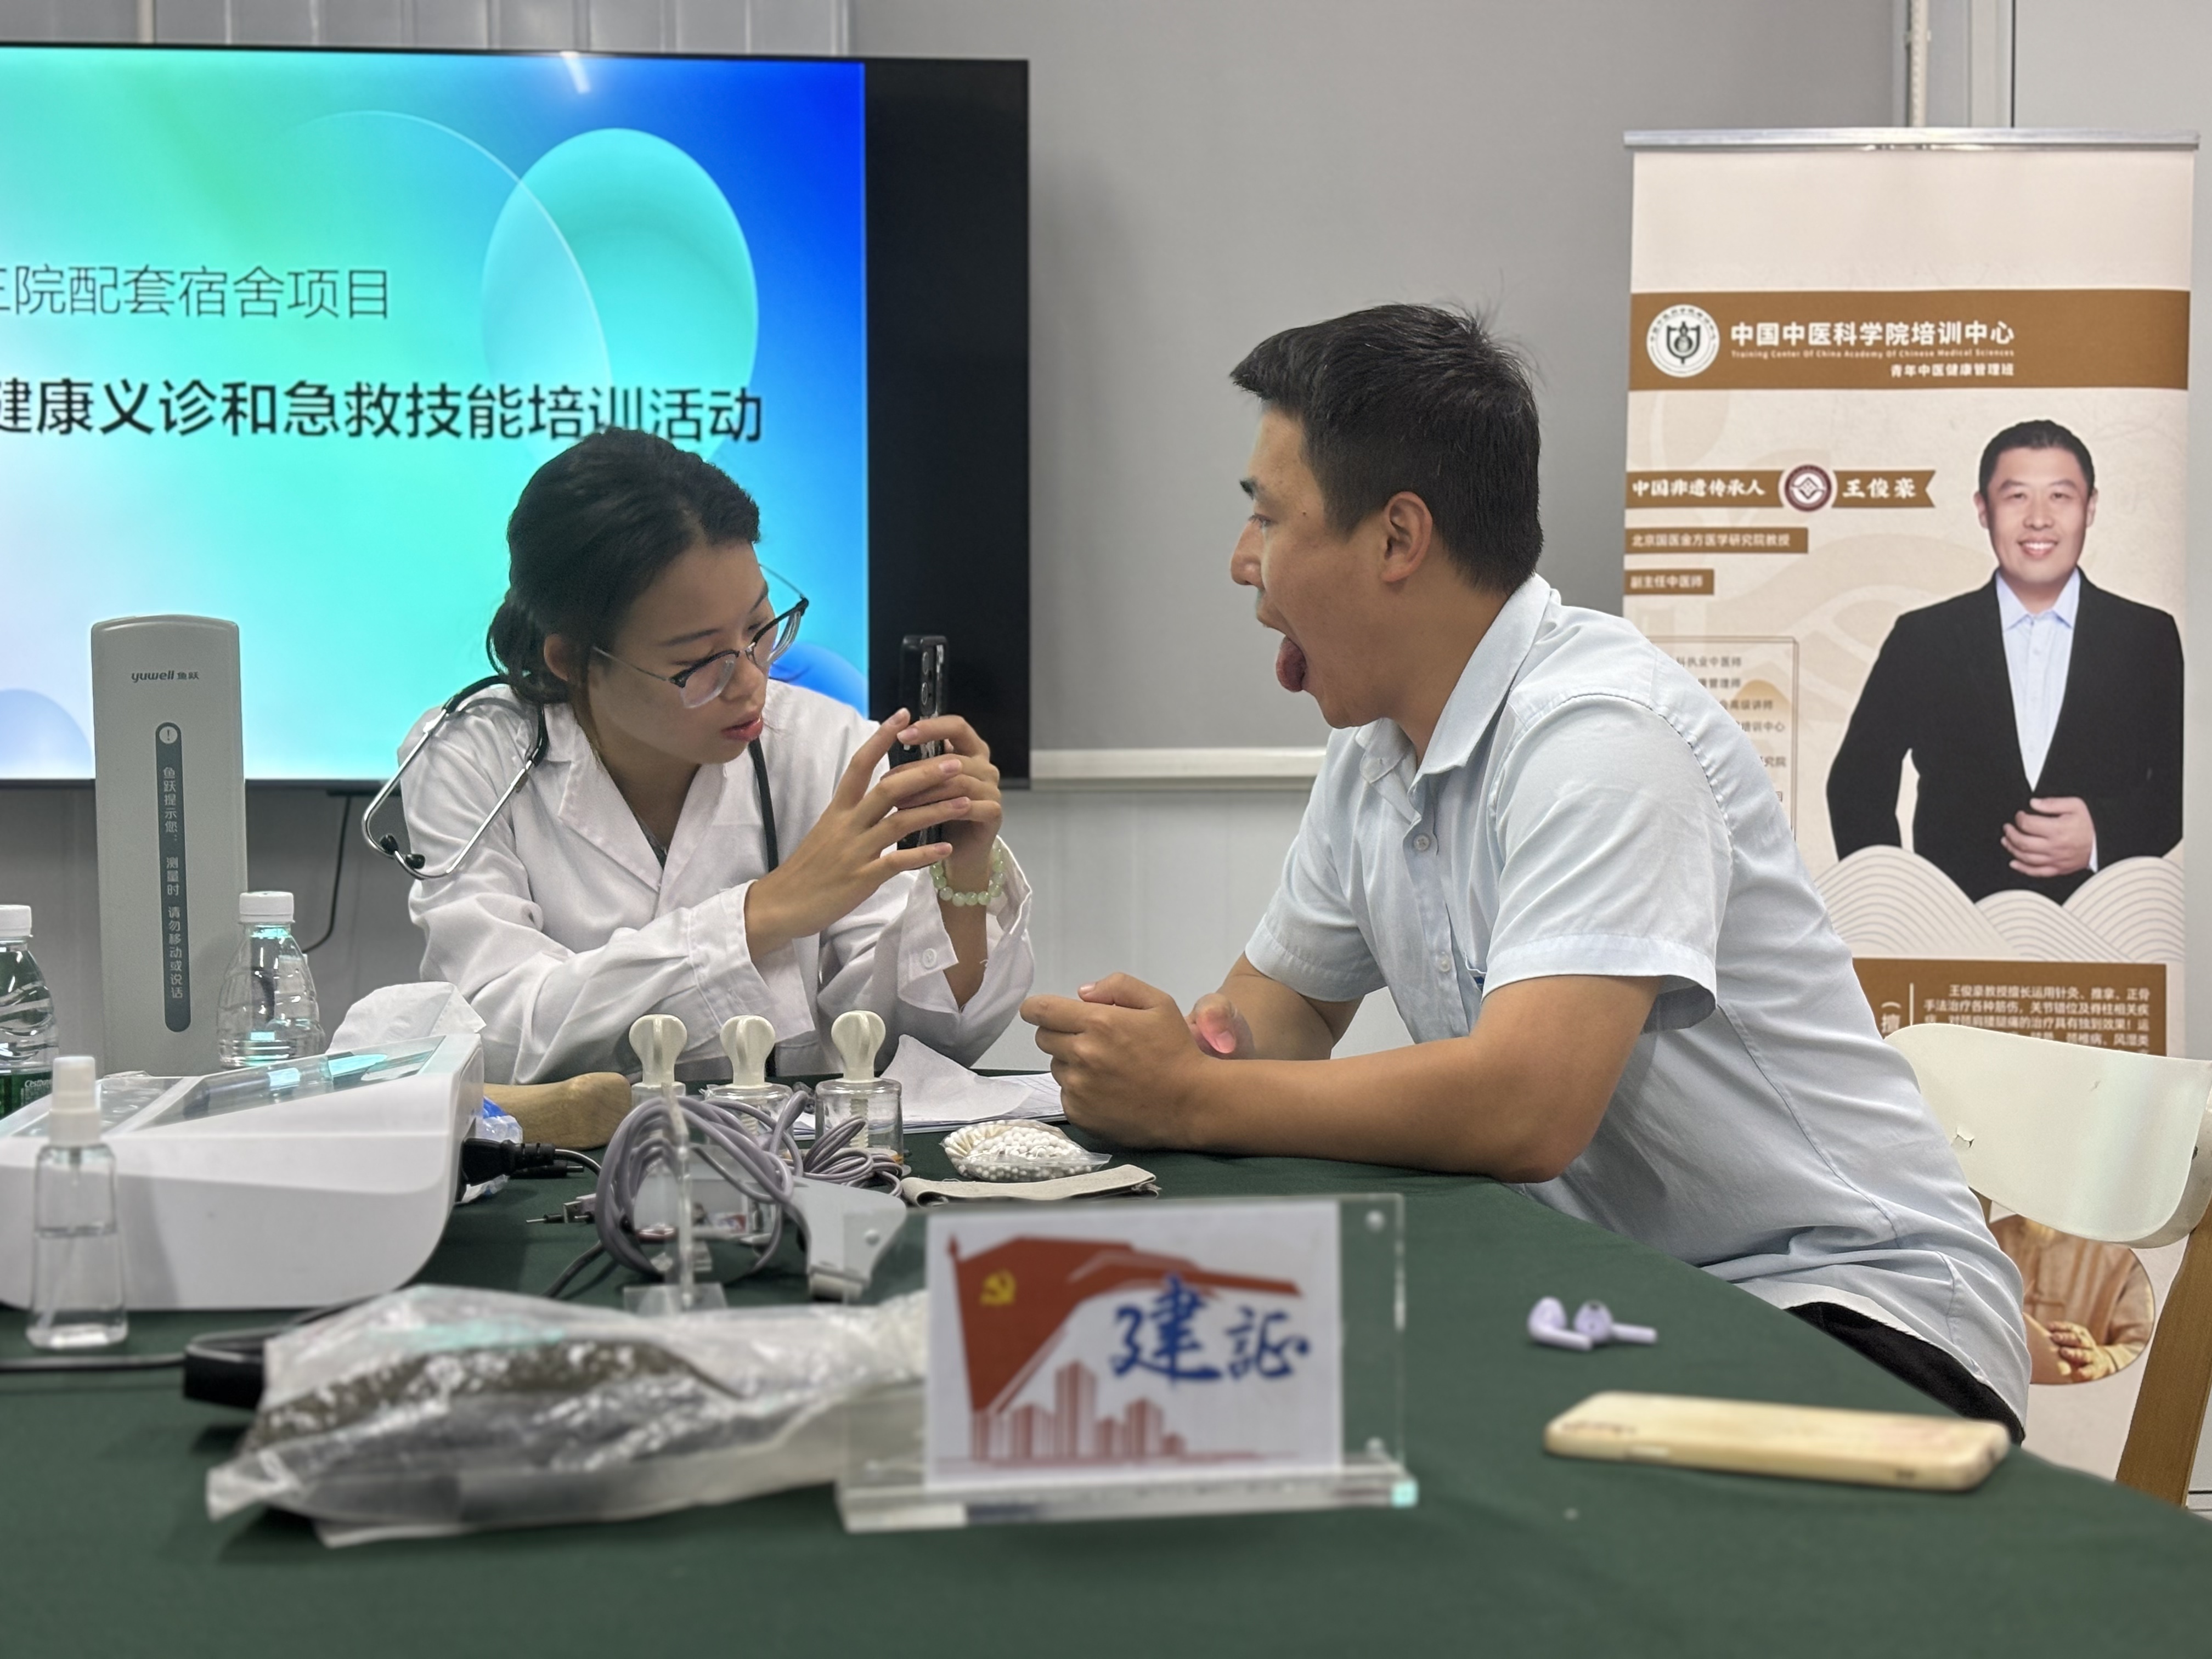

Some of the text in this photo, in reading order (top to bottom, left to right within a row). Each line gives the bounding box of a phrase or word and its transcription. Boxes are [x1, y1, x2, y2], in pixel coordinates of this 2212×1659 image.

[0, 264, 388, 319] 院配套宿舍项目
[1731, 320, 2015, 347] 中国中医科学院培训中心
[1632, 478, 1765, 498] 中国非遗传承人
[131, 670, 175, 684] yuwell
[168, 906, 183, 999] 请勿移动或说话
